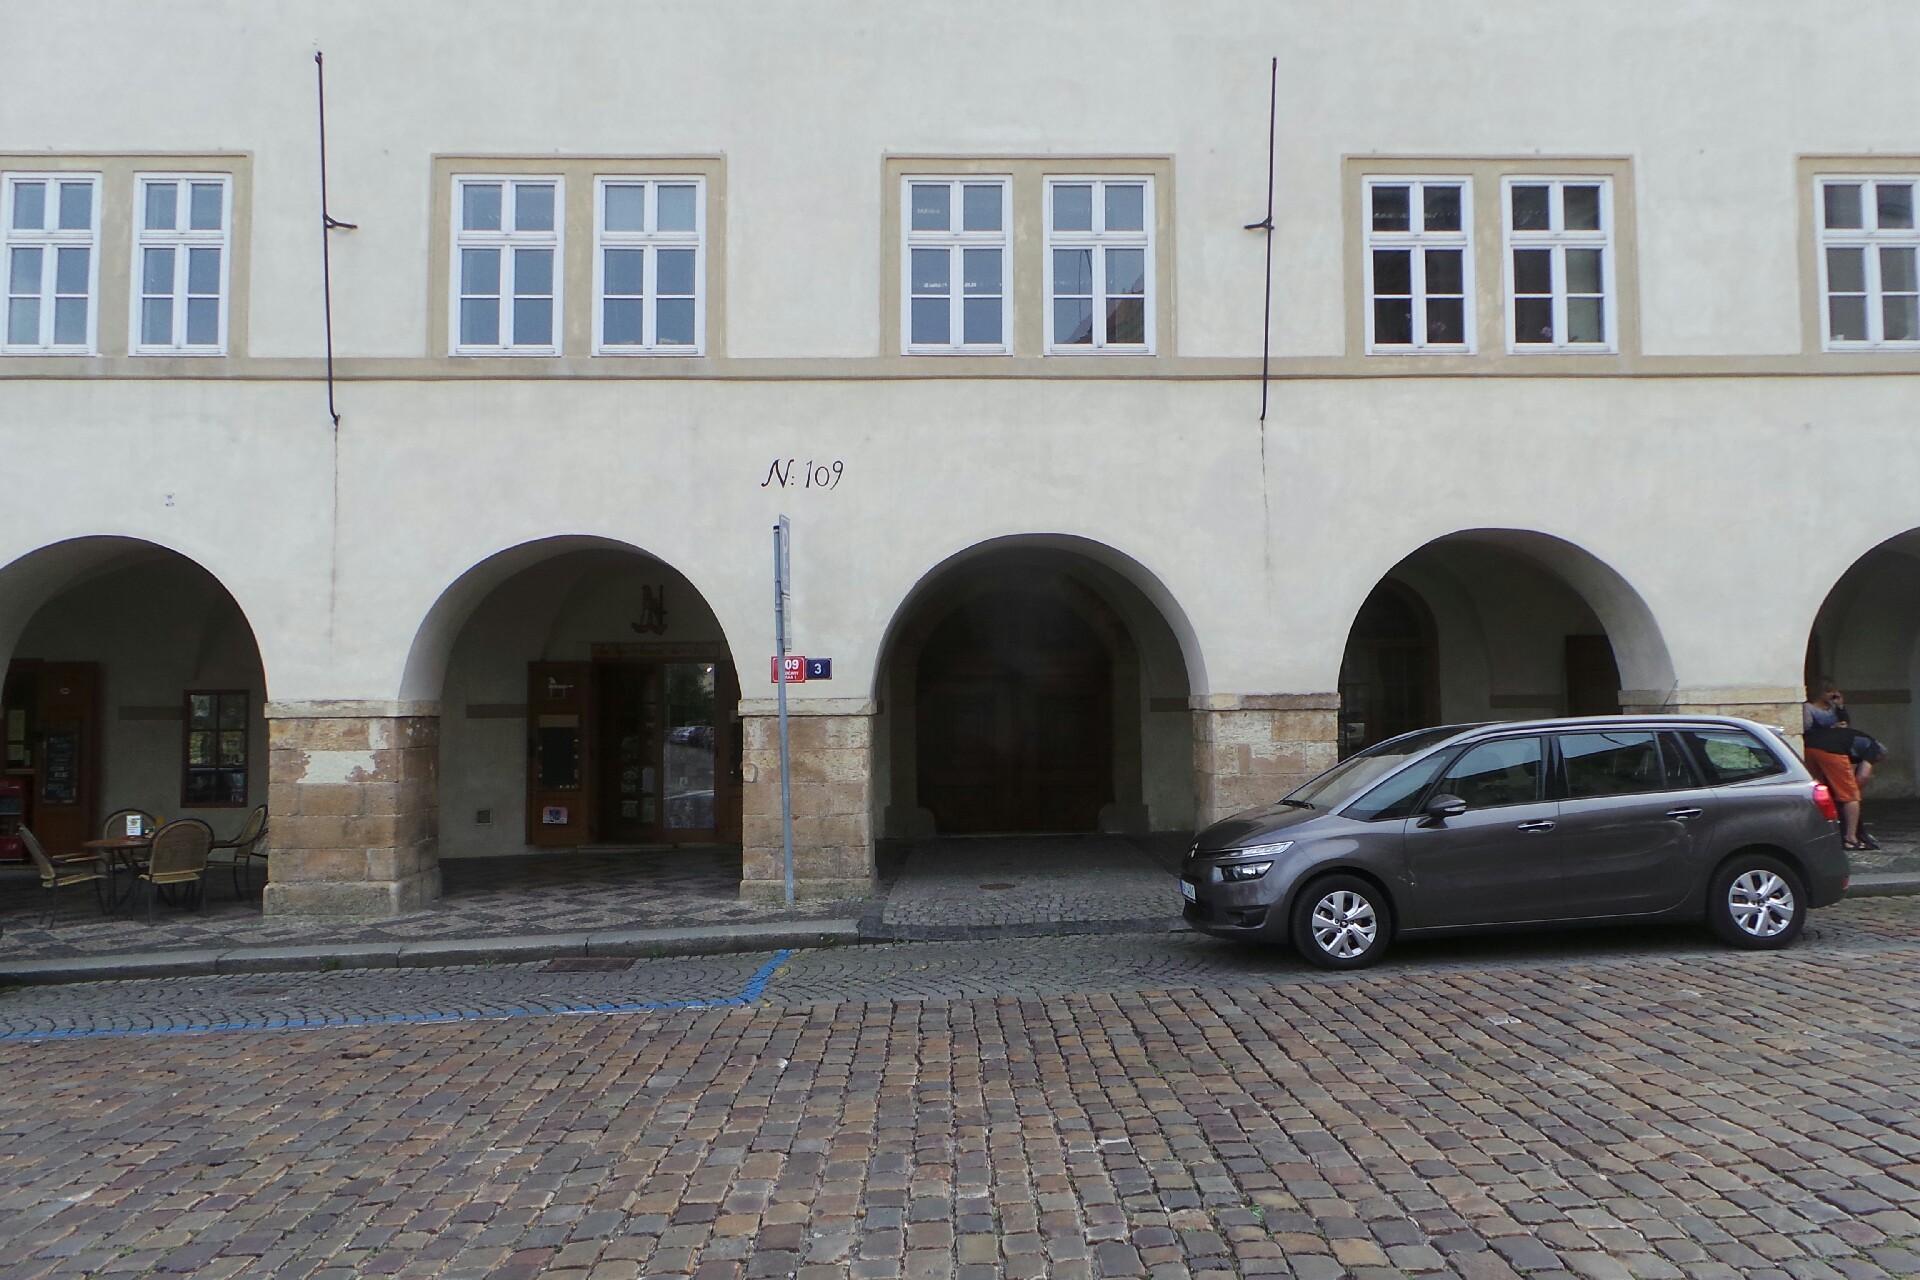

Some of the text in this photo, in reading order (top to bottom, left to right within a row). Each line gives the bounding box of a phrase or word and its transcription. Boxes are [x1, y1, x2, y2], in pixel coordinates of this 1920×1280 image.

[805, 460, 844, 490] 109
[784, 659, 799, 670] 09
[814, 663, 822, 674] 3
